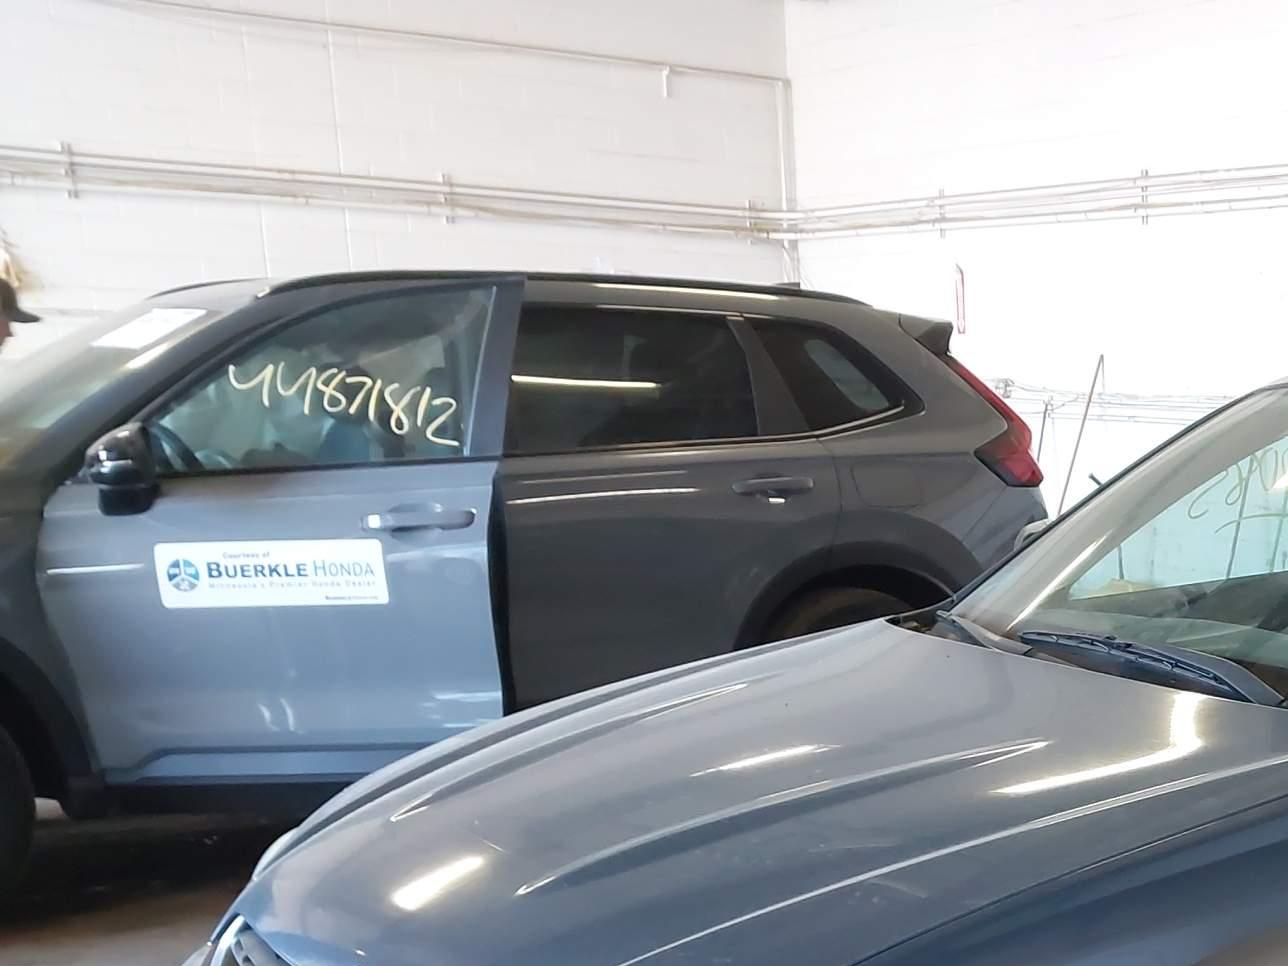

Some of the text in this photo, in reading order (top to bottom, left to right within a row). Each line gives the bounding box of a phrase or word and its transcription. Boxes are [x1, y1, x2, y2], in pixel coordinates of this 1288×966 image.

[228, 362, 460, 446] 44871812
[206, 561, 309, 579] BUERKLE
[313, 560, 375, 577] HONDA
